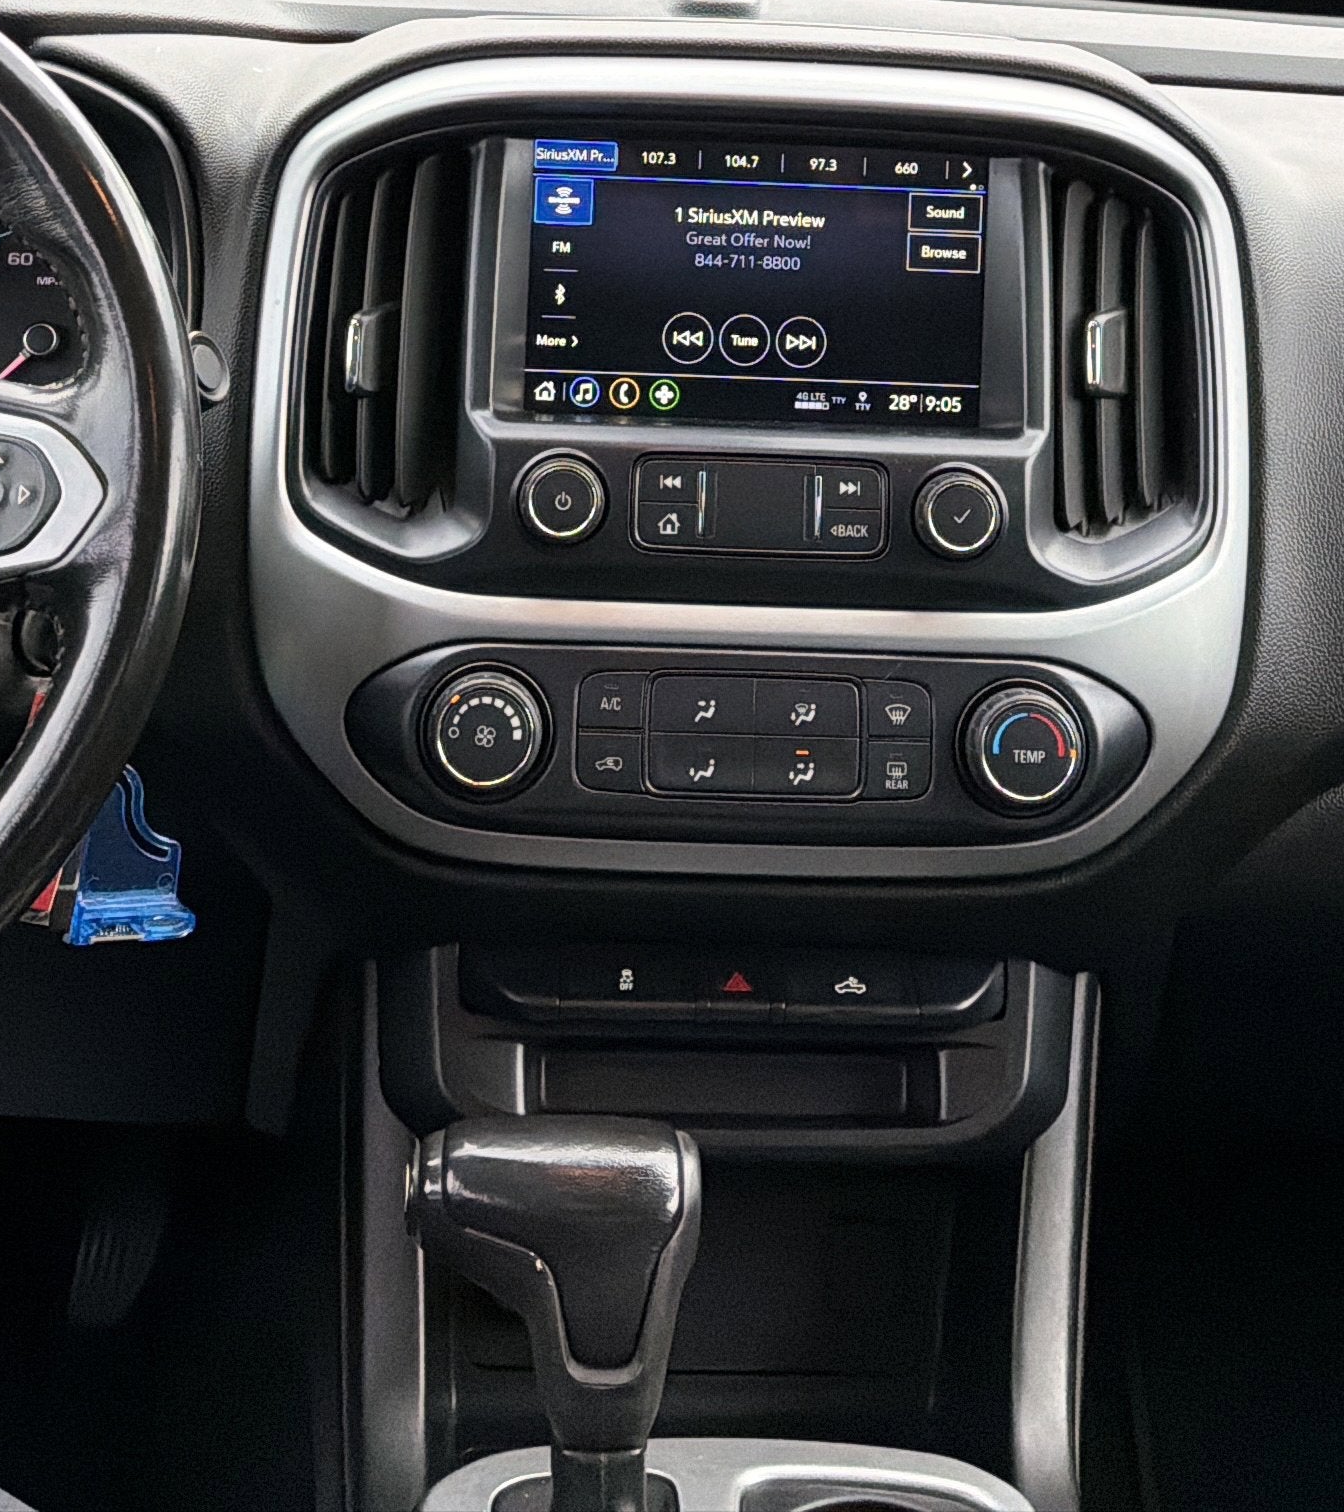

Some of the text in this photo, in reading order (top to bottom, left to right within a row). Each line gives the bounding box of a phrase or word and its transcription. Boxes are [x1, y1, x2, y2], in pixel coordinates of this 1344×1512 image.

[536, 147, 588, 162] SiriusXM
[641, 151, 677, 165] 107.3
[725, 155, 759, 169] 104.7
[809, 158, 838, 172] 97.3
[894, 162, 919, 175] 660
[674, 206, 826, 228] 1 SiriusXM Preview
[925, 205, 965, 220] Sound
[552, 241, 571, 254] FM
[686, 231, 811, 250] Great Offer Now!
[7, 252, 34, 267] 60
[920, 245, 967, 261] Browse
[694, 253, 801, 271] 844-711-8800
[36, 276, 63, 287] MP
[536, 334, 567, 347] More
[730, 334, 759, 347] Tune
[796, 391, 826, 401] 4G LTE
[831, 396, 847, 405] TTY
[855, 402, 872, 411] TTY
[925, 396, 963, 413] 9:05
[838, 524, 869, 538] BACK
[600, 696, 622, 711] A/C
[1013, 749, 1046, 764] TEMP
[885, 779, 909, 790] REAR
[619, 982, 634, 991] OFF
